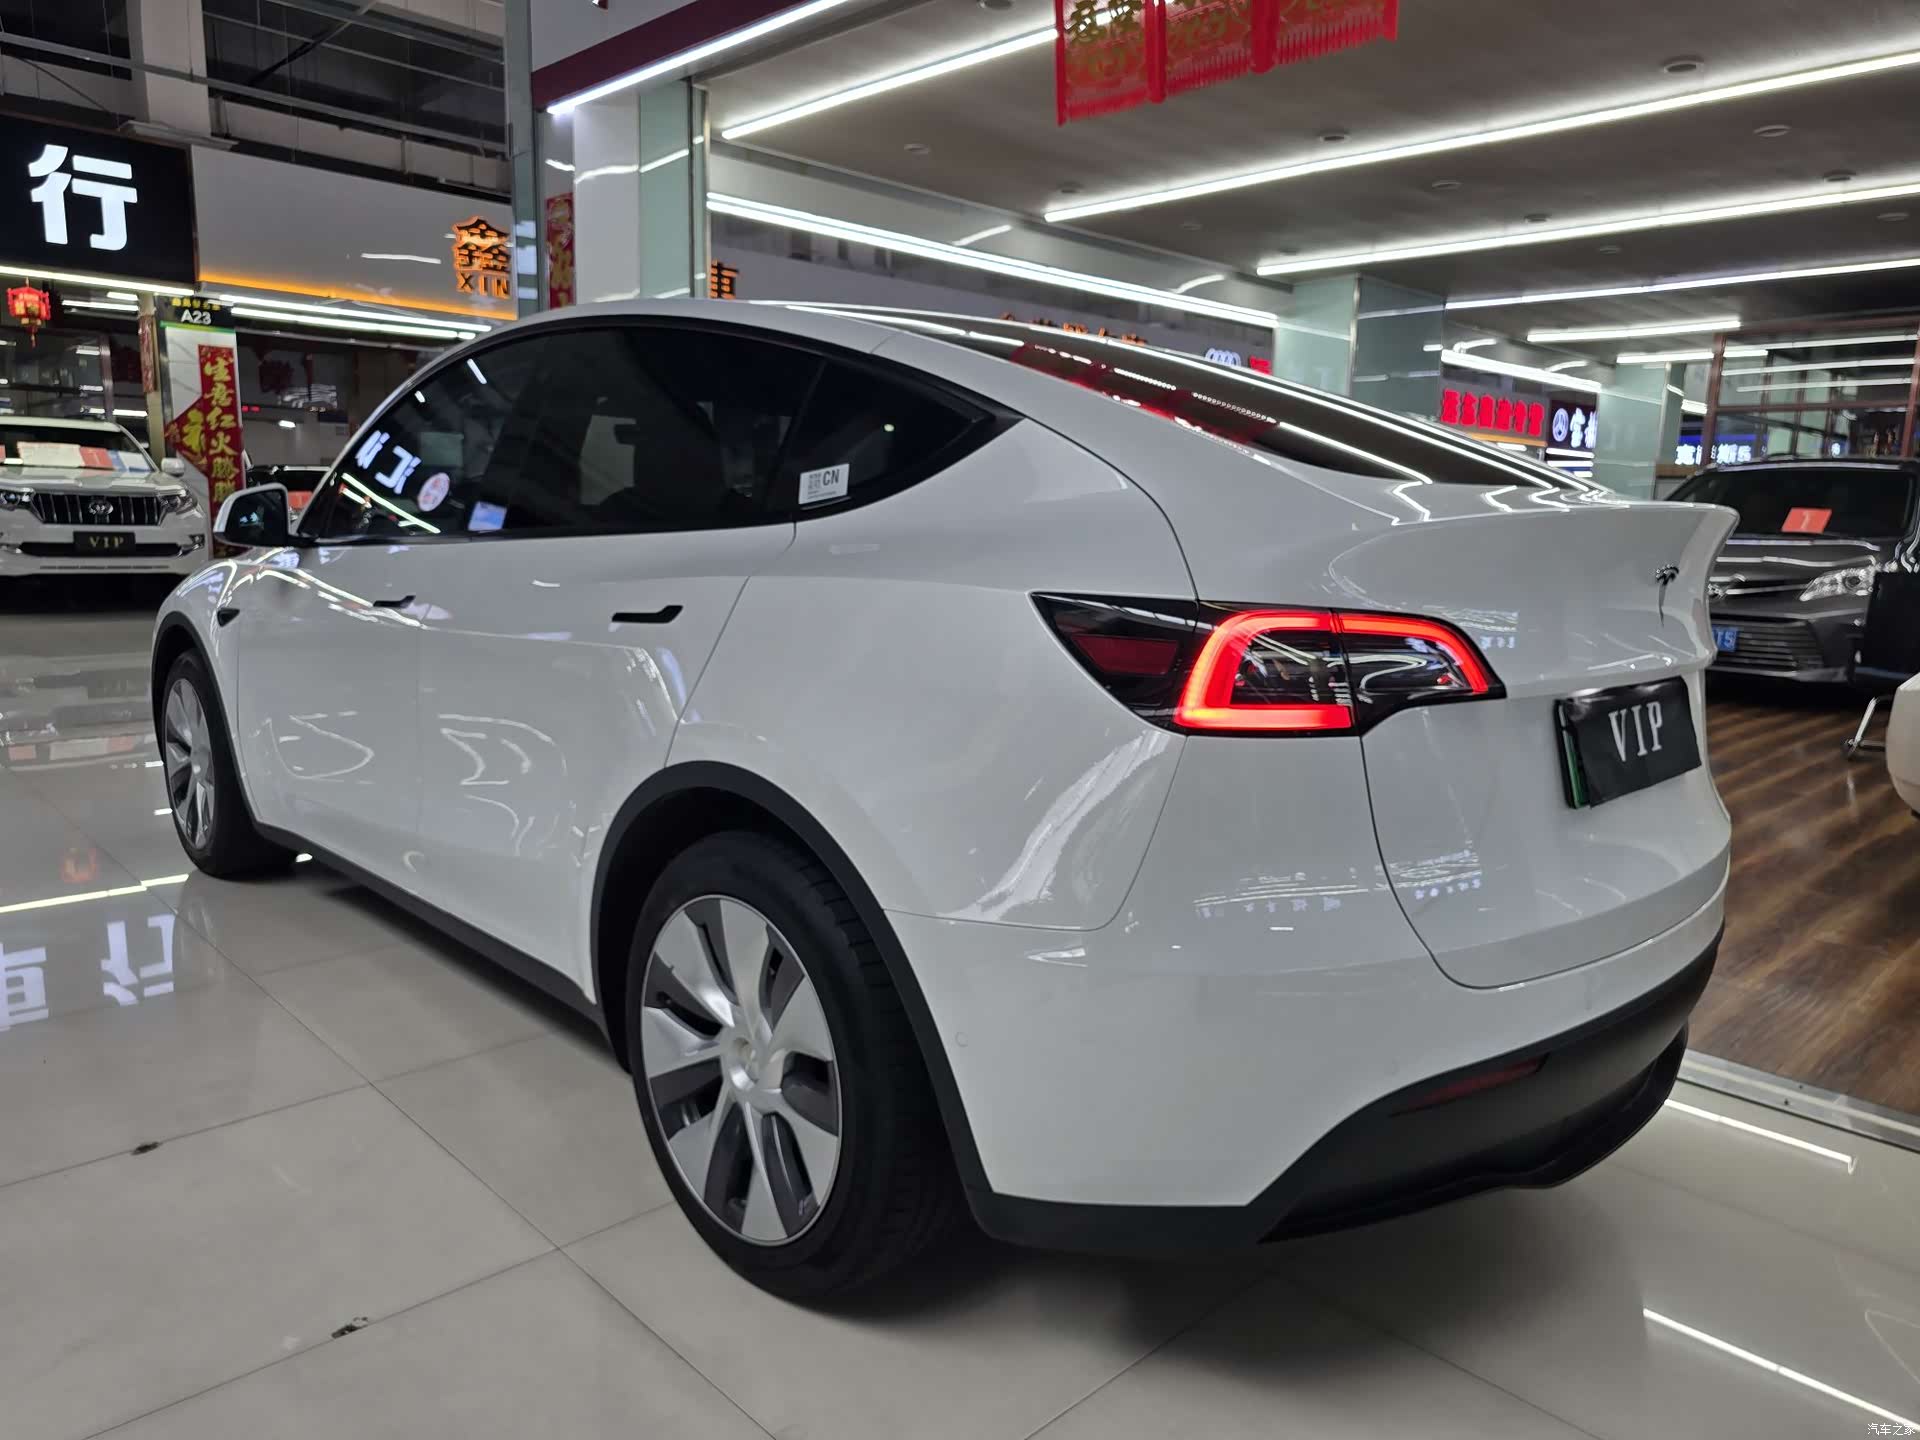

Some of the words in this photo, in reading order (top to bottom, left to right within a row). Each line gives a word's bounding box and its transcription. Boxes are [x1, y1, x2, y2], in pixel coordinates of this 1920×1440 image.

[28, 144, 138, 251] 行
[454, 217, 510, 274] 鑫
[458, 272, 510, 297] XIN
[181, 309, 212, 325] A23
[823, 469, 840, 486] CN
[88, 536, 125, 549] VIP
[1608, 701, 1663, 762] VIP
